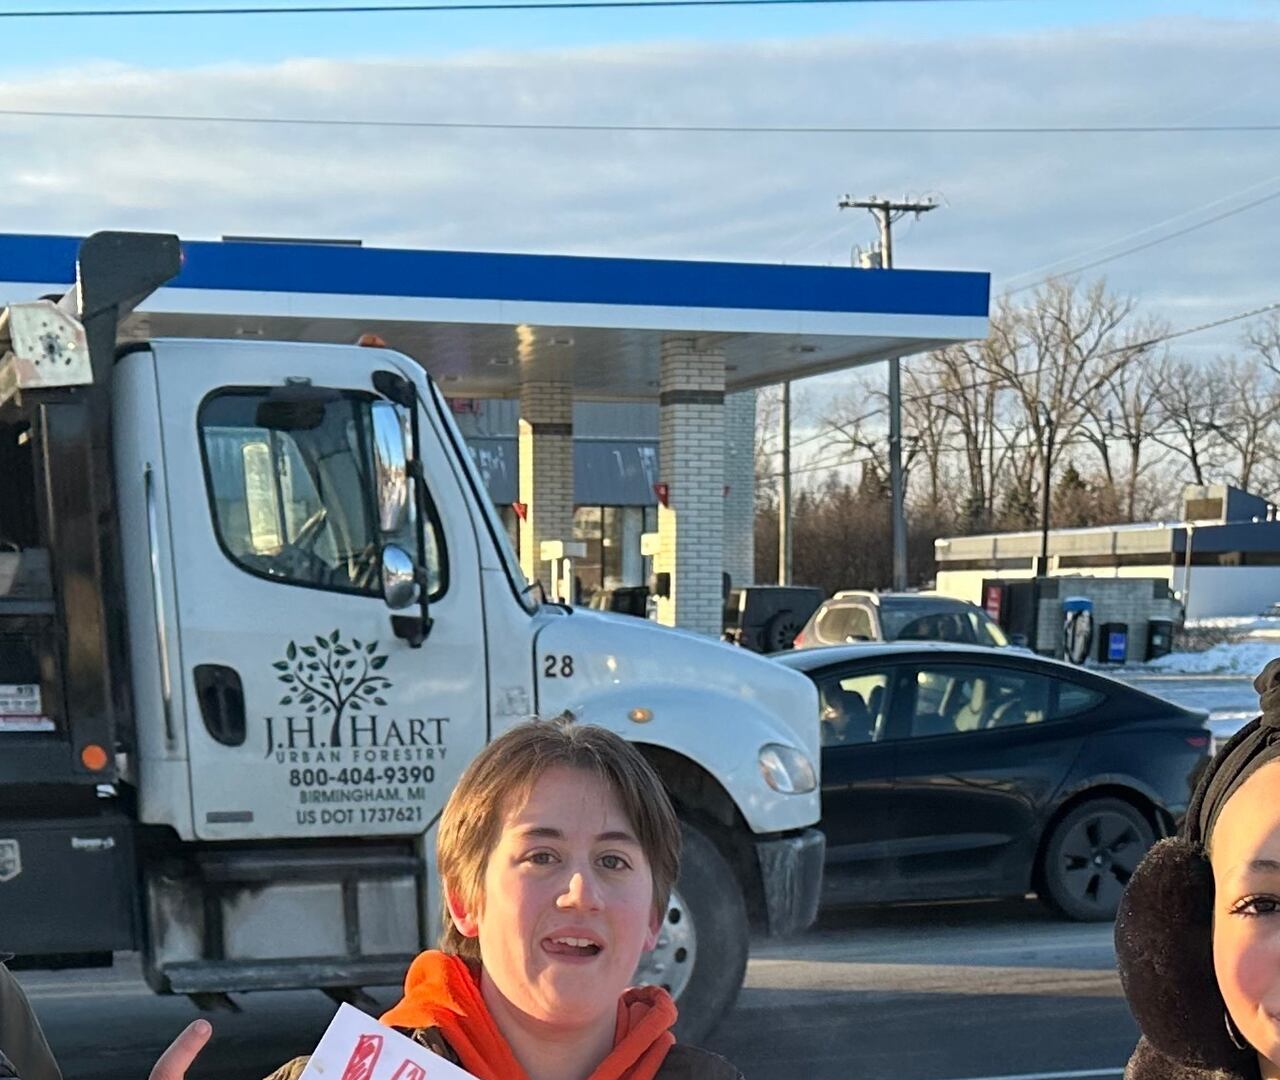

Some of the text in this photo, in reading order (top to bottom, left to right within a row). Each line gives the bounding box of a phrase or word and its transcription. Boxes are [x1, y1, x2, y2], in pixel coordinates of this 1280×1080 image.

[544, 654, 574, 678] 28
[264, 714, 450, 759] J.H. HART
[275, 747, 448, 764] URBAN FORESTRY
[288, 765, 435, 787] 800-404-9390
[299, 787, 426, 804] BIRMINGHAM, MI
[296, 807, 423, 825] US DOT 1737621
